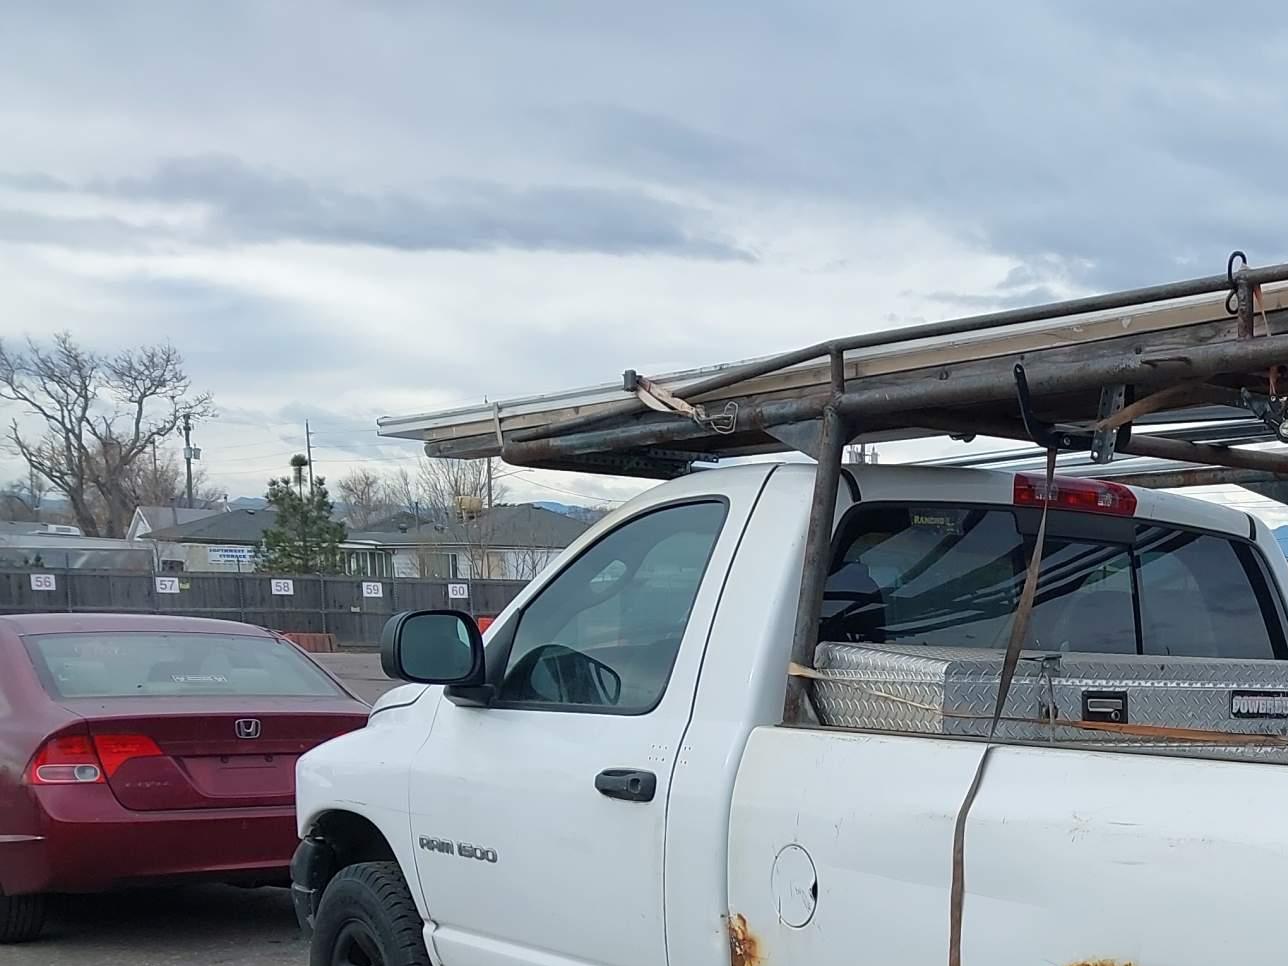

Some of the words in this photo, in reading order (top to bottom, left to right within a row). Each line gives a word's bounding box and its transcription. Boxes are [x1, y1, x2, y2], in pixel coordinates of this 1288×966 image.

[35, 576, 51, 588] 56
[159, 579, 175, 591] 57
[275, 582, 290, 593] 58
[365, 584, 380, 596] 59
[451, 585, 466, 597] 60
[419, 835, 455, 857] RAM
[457, 842, 498, 864] 1500
